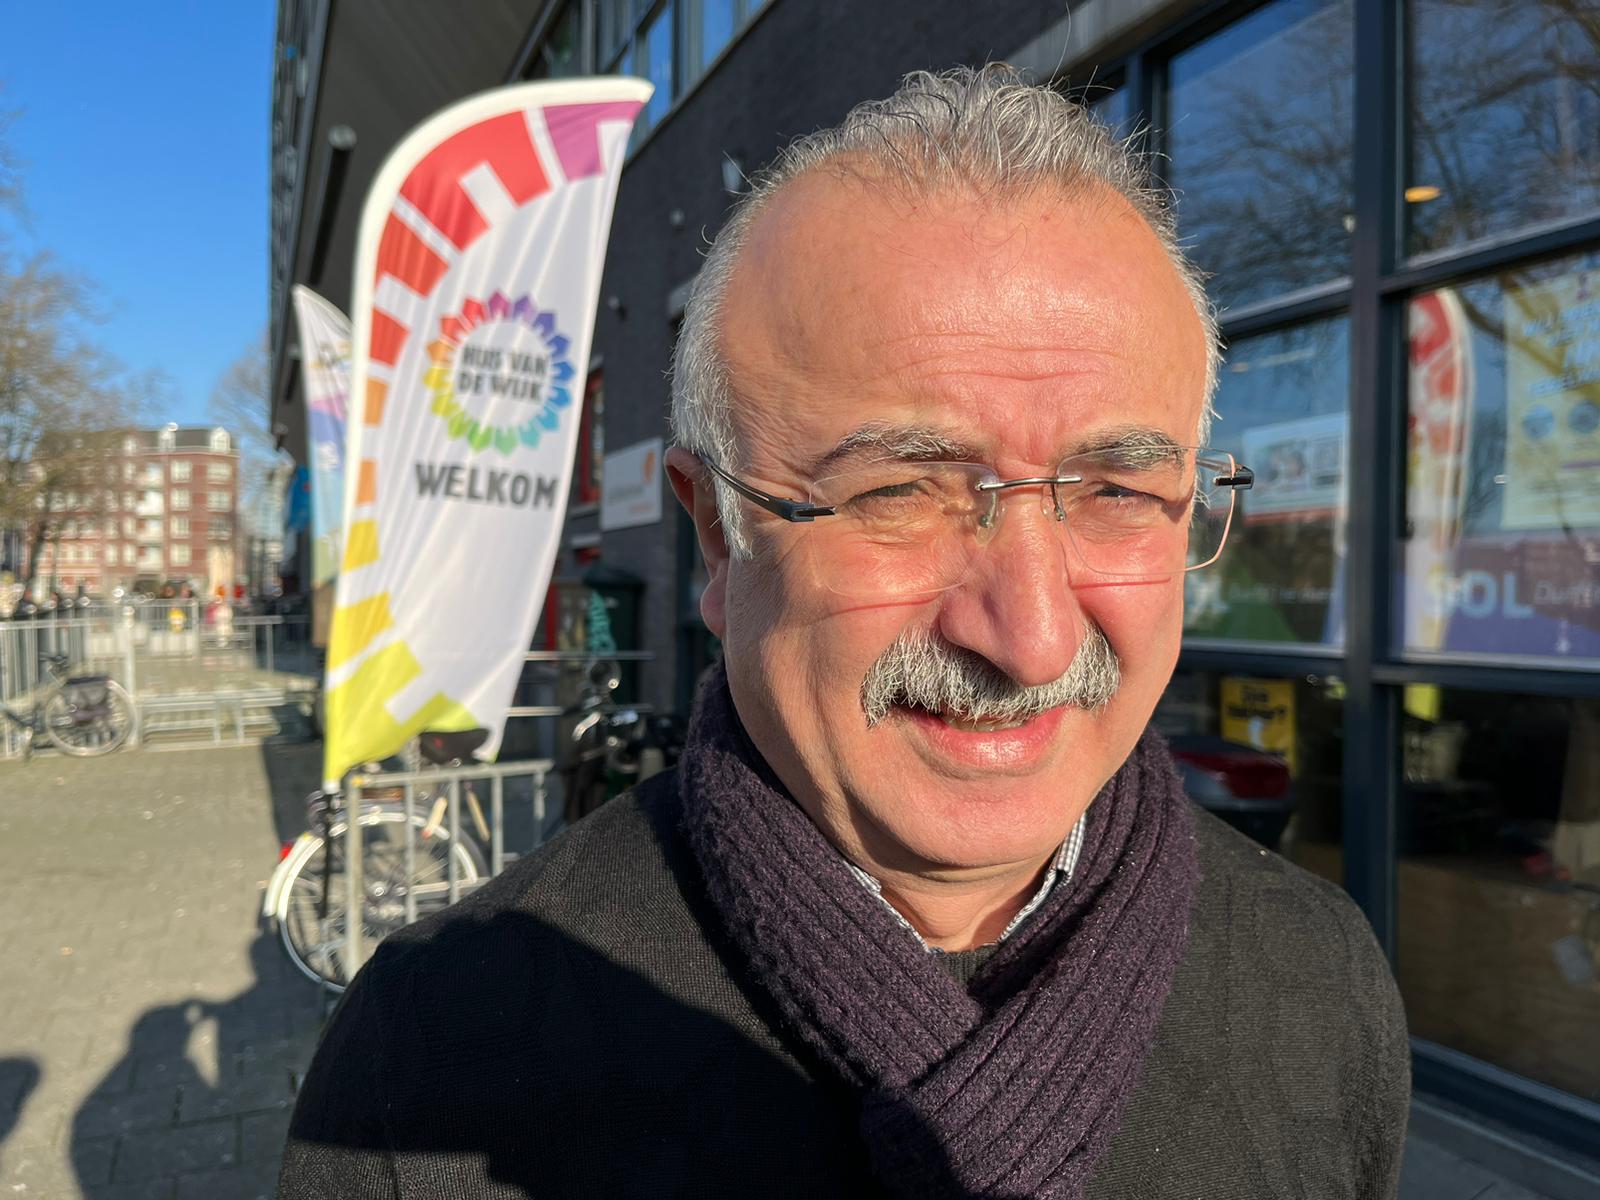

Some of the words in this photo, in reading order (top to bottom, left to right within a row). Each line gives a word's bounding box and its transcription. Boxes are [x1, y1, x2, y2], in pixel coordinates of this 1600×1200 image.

[462, 346, 501, 369] HUIS
[510, 350, 549, 376] VAN
[458, 371, 482, 394] DE
[490, 374, 543, 402] WIJK
[415, 461, 559, 510] WELKOM
